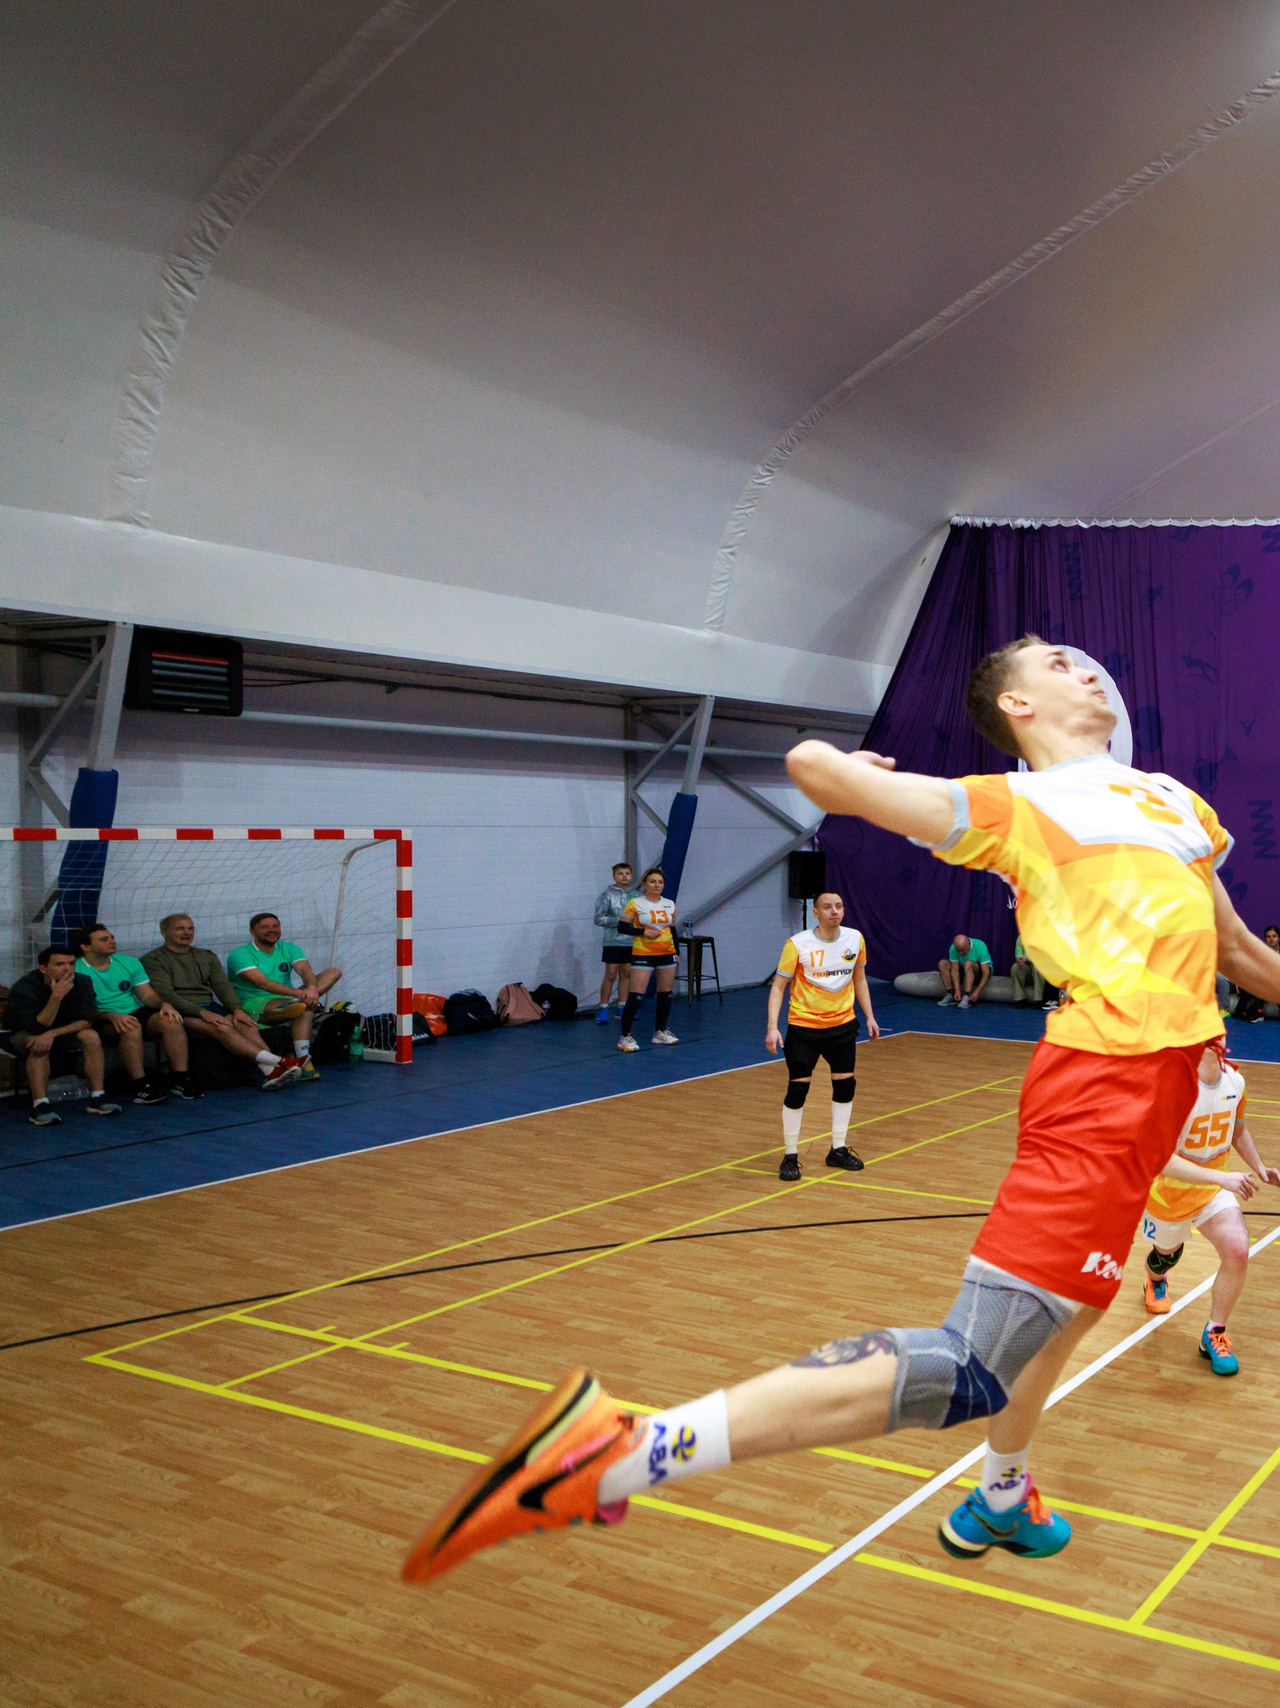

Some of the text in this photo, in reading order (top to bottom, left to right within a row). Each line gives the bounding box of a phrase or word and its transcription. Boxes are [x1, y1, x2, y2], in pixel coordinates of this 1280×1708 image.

[649, 910, 669, 924] 13
[809, 949, 825, 967] 17
[1184, 1110, 1232, 1150] 55
[1143, 1218, 1157, 1240] 12
